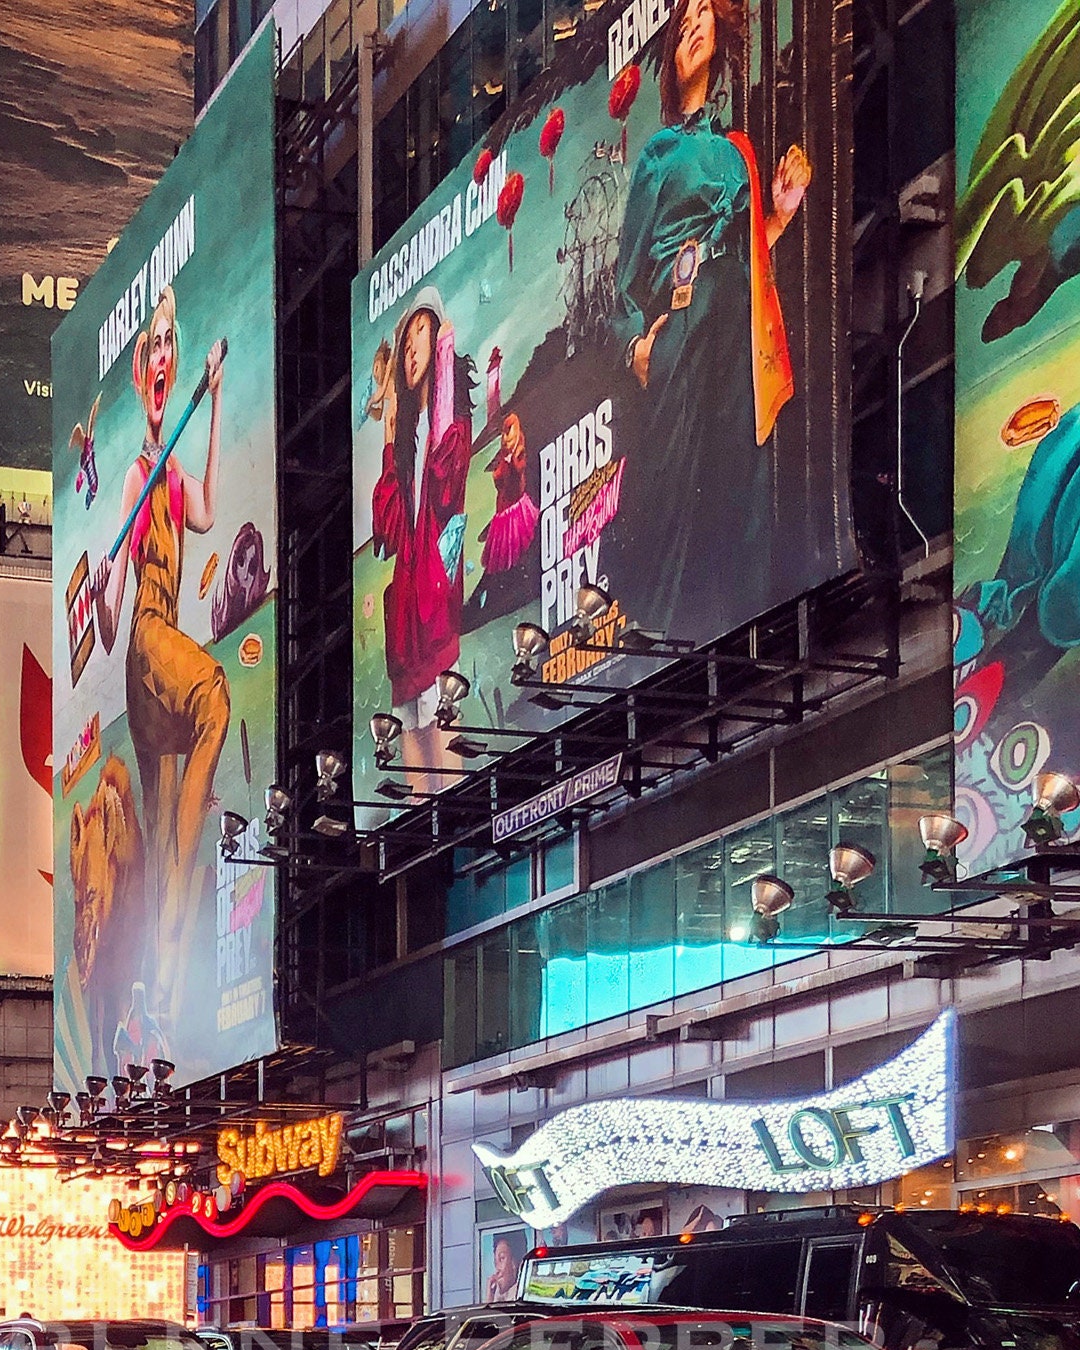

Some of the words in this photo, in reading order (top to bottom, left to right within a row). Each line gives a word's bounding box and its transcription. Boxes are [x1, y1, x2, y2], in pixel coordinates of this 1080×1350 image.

[99, 260, 149, 382] HARLEY
[150, 194, 195, 310] QUINN
[368, 192, 462, 324] CASSANDRA
[540, 399, 613, 511] BIRDS
[541, 497, 572, 571] OF
[495, 785, 566, 837] OUTFRONT
[574, 761, 615, 798] PRIME
[217, 1113, 343, 1186] Subway
[752, 1093, 916, 1174] LOFT
